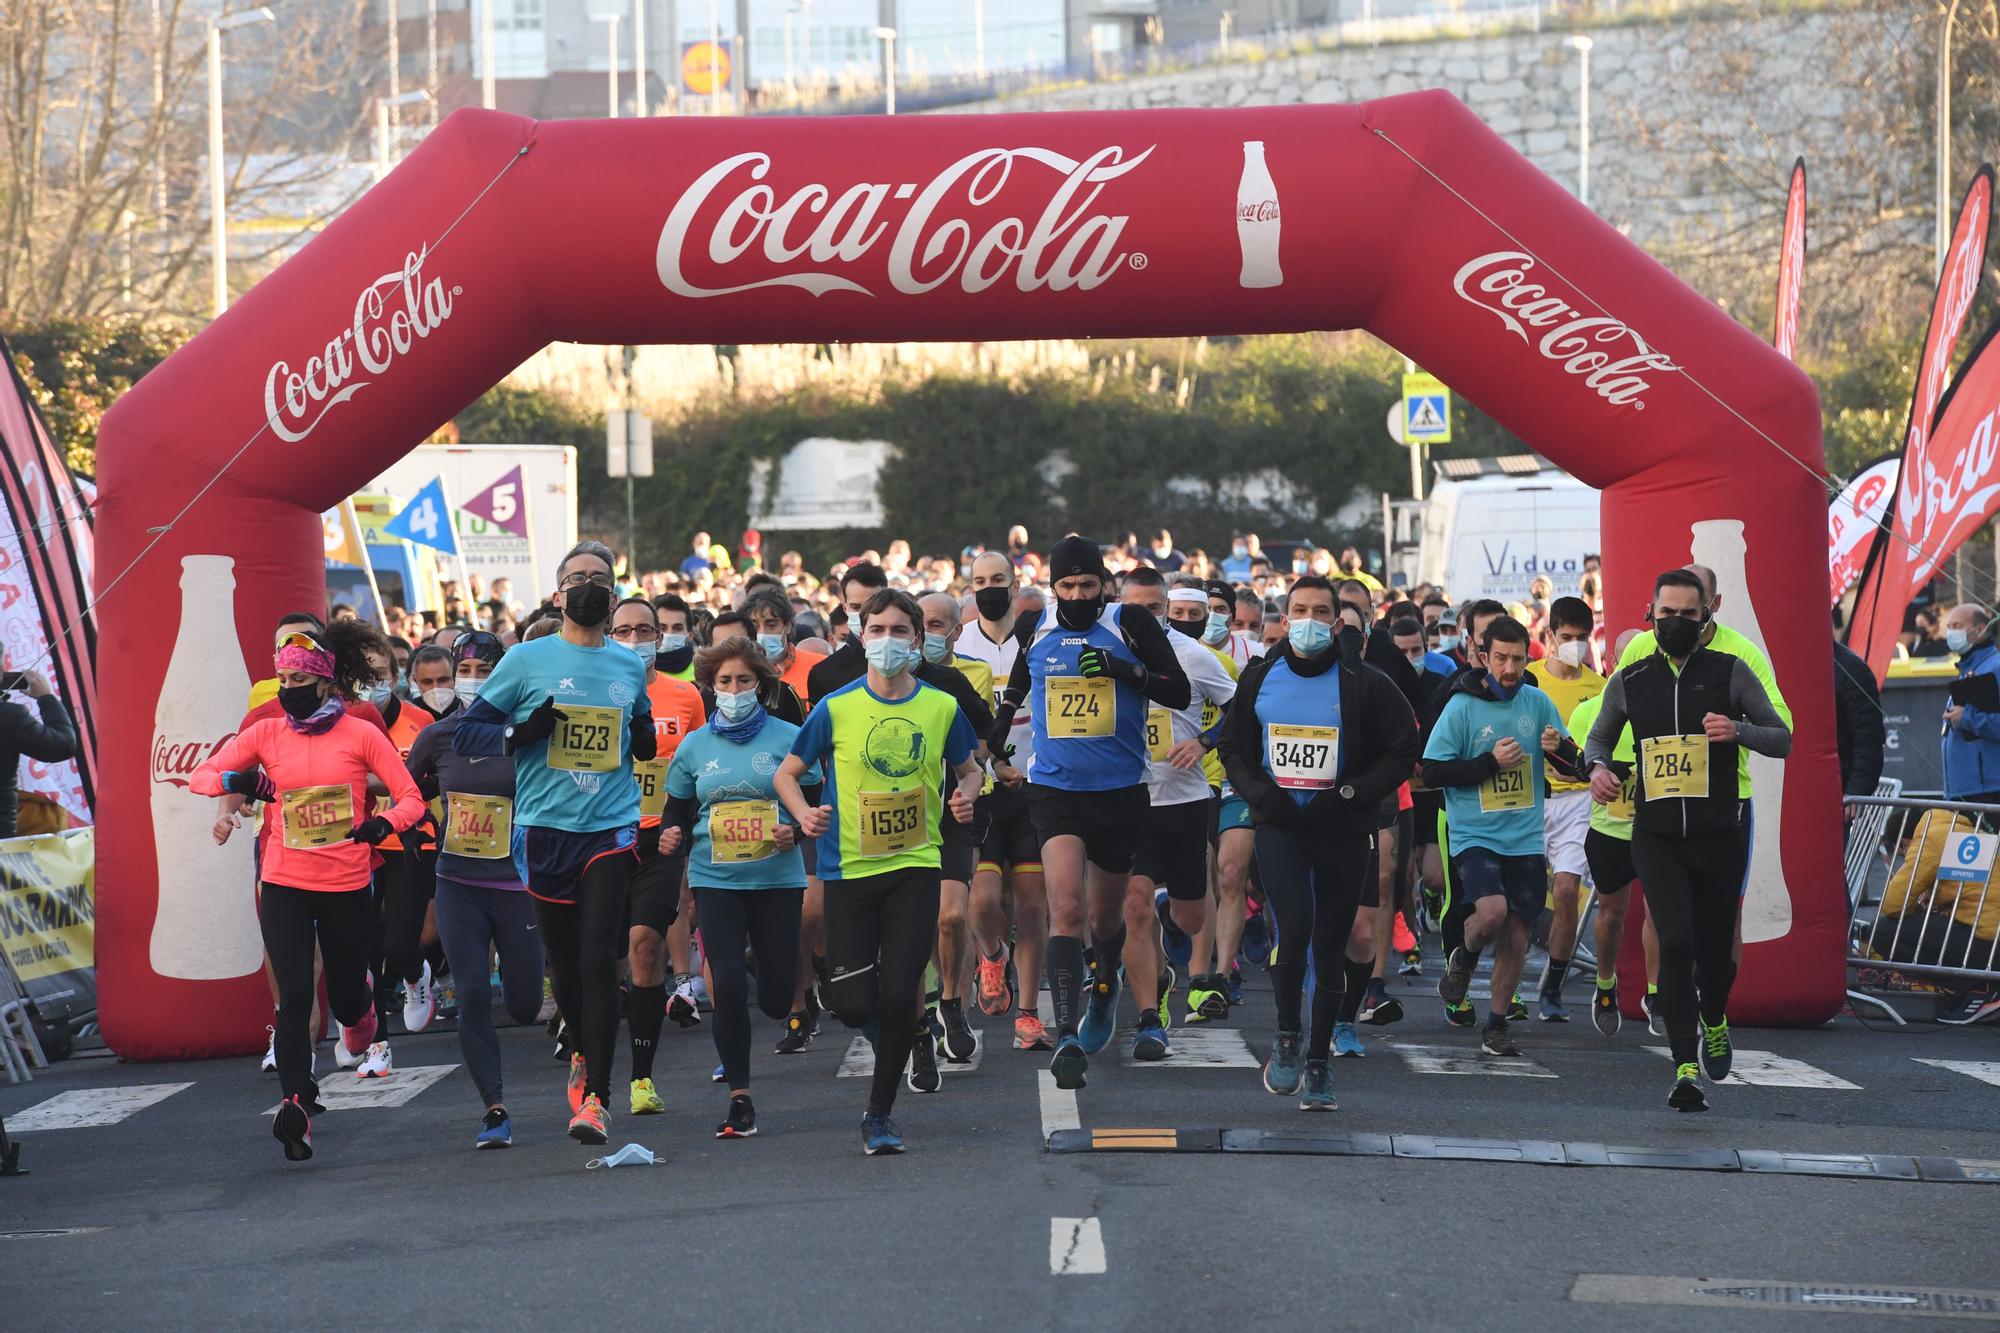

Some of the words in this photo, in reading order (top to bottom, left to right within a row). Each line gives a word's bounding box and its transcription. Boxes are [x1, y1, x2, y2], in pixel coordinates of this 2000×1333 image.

[655, 143, 1157, 298] Coca-Cola
[264, 240, 453, 443] Coca-Cola
[1453, 250, 1685, 405] Coca-Cola
[490, 482, 518, 523] 5
[408, 497, 439, 541] 4
[1060, 693, 1100, 718] 224
[562, 723, 610, 752] 1523
[1276, 742, 1329, 769] 3487
[1654, 752, 1693, 779] 284
[1492, 770, 1524, 794] 1521
[294, 801, 338, 829] 365
[457, 810, 495, 838] 344
[870, 804, 918, 836] 1533
[722, 817, 765, 844] 358
